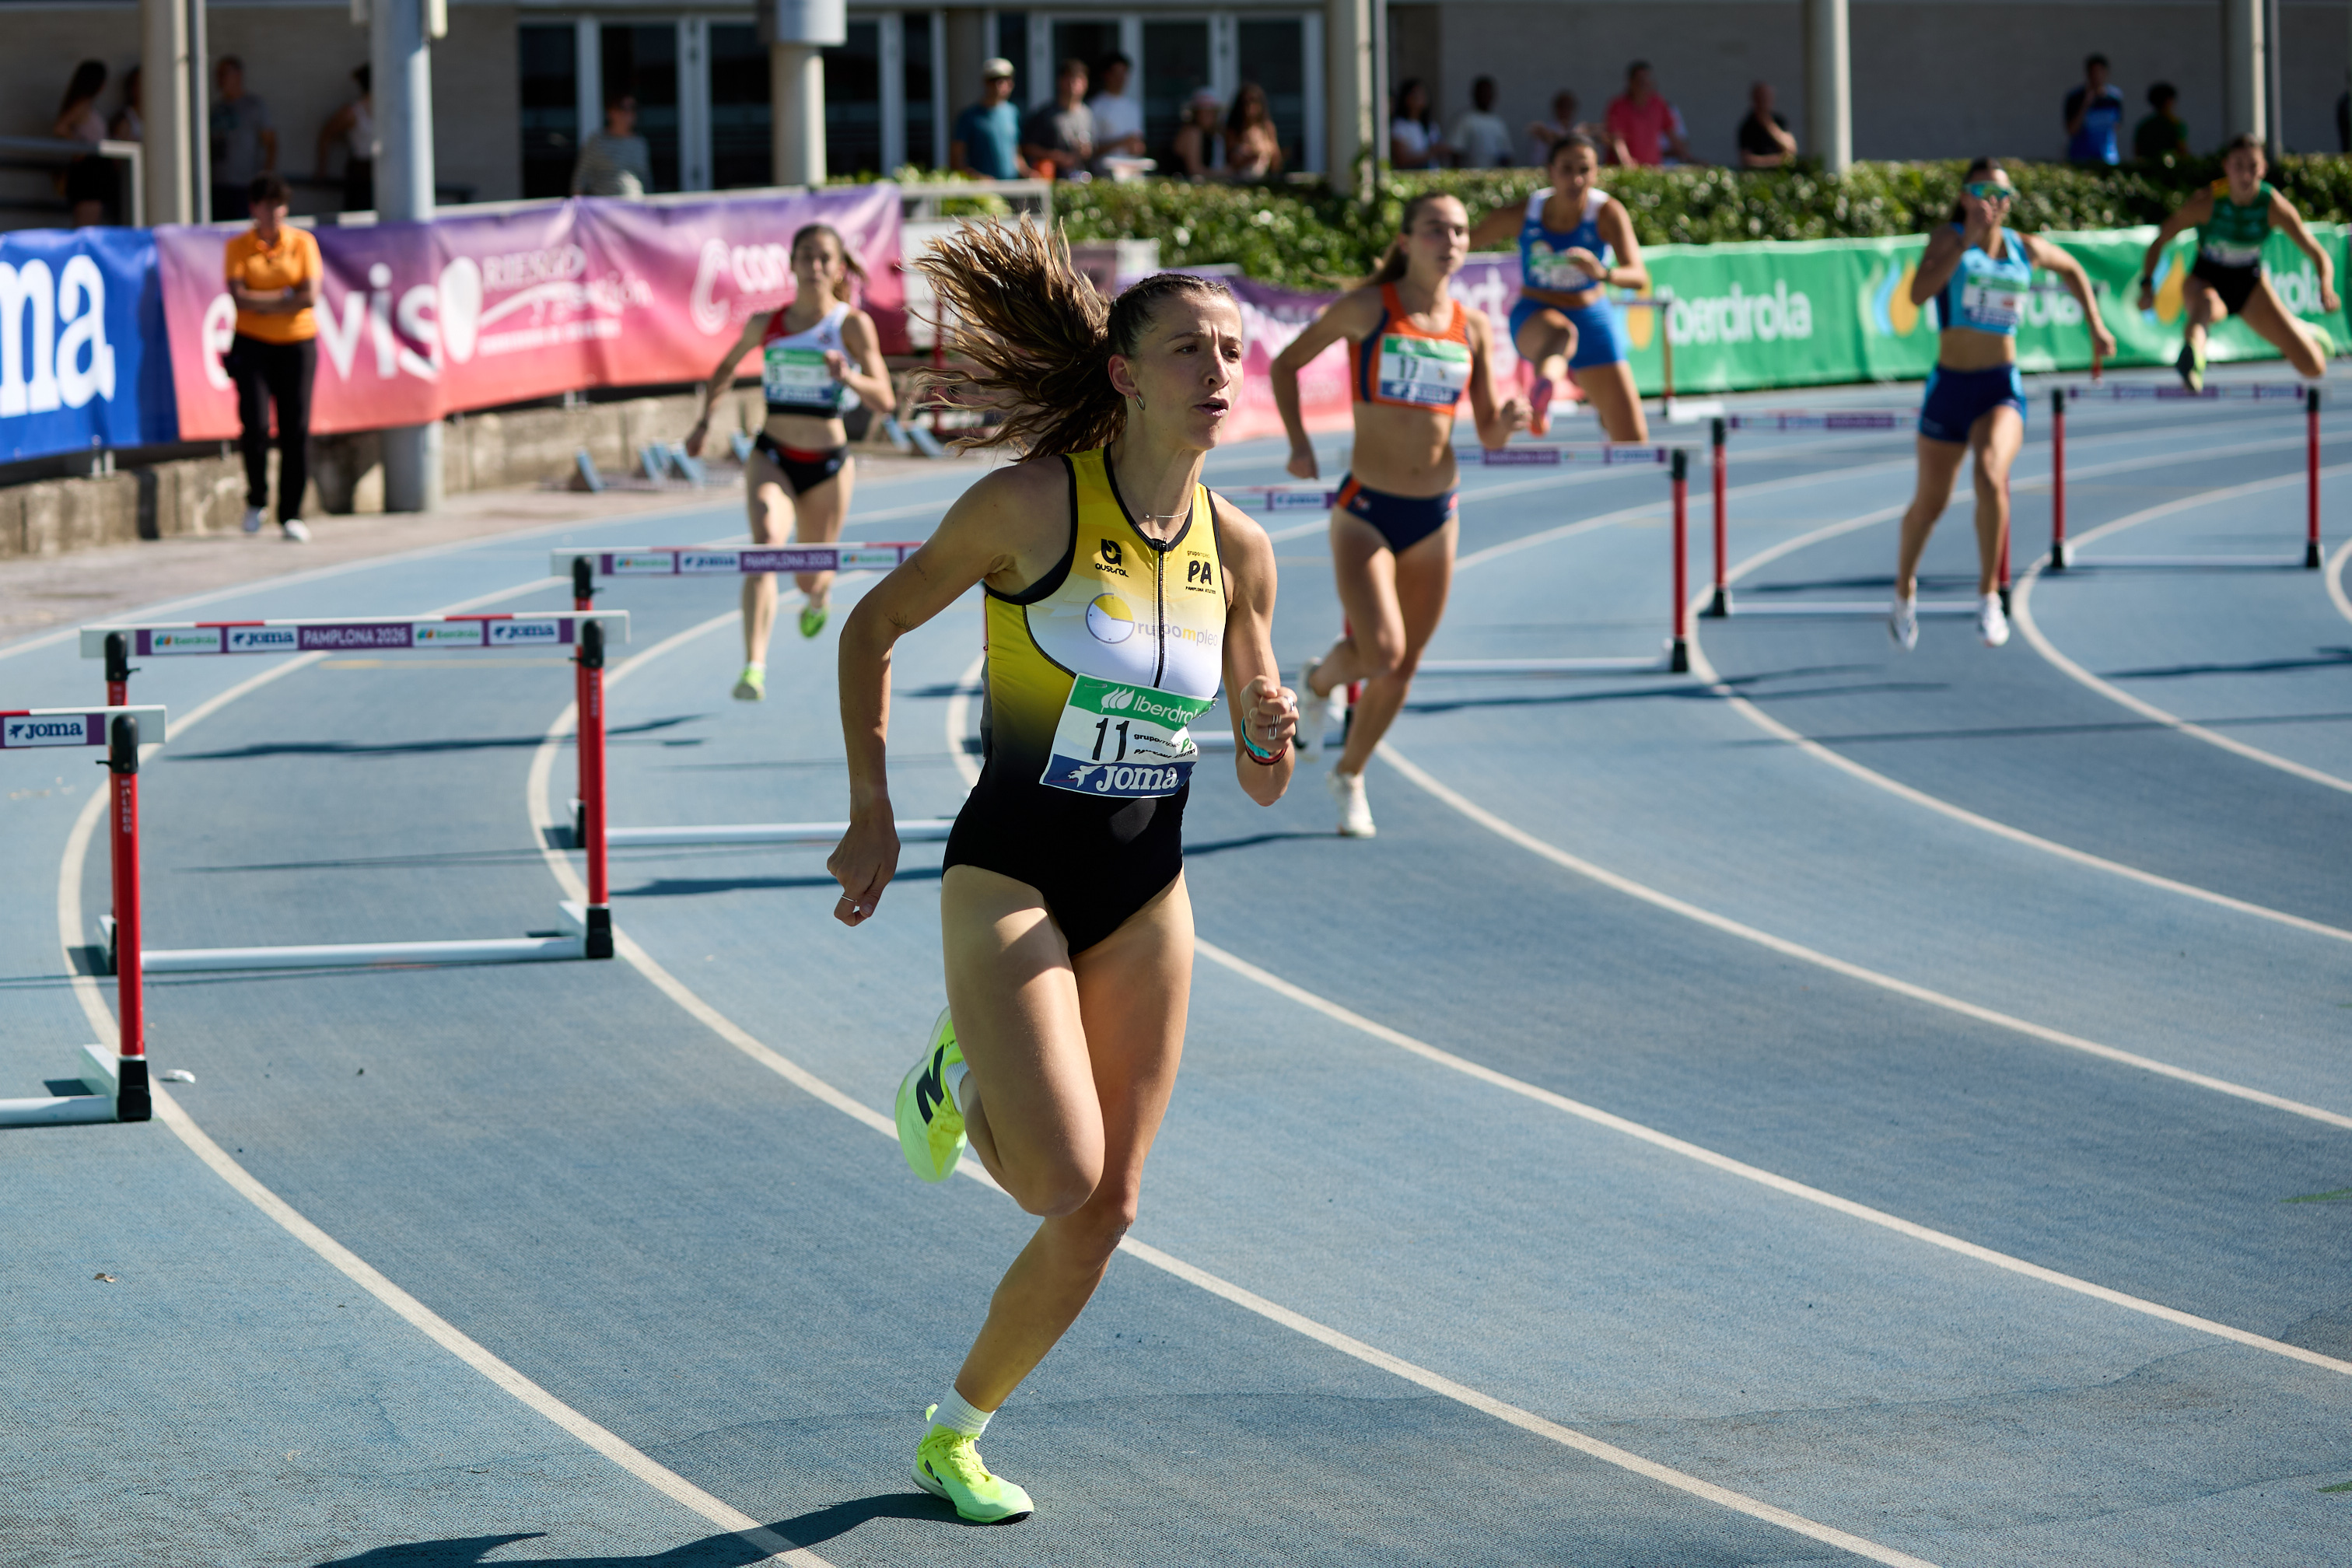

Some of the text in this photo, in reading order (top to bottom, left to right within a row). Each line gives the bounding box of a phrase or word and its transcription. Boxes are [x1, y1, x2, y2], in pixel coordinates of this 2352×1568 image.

[1188, 560, 1212, 586] PA
[303, 628, 374, 646] PAMPLONA
[375, 627, 407, 645] 2026
[1092, 717, 1130, 762] 11
[1095, 765, 1179, 793] Joma
